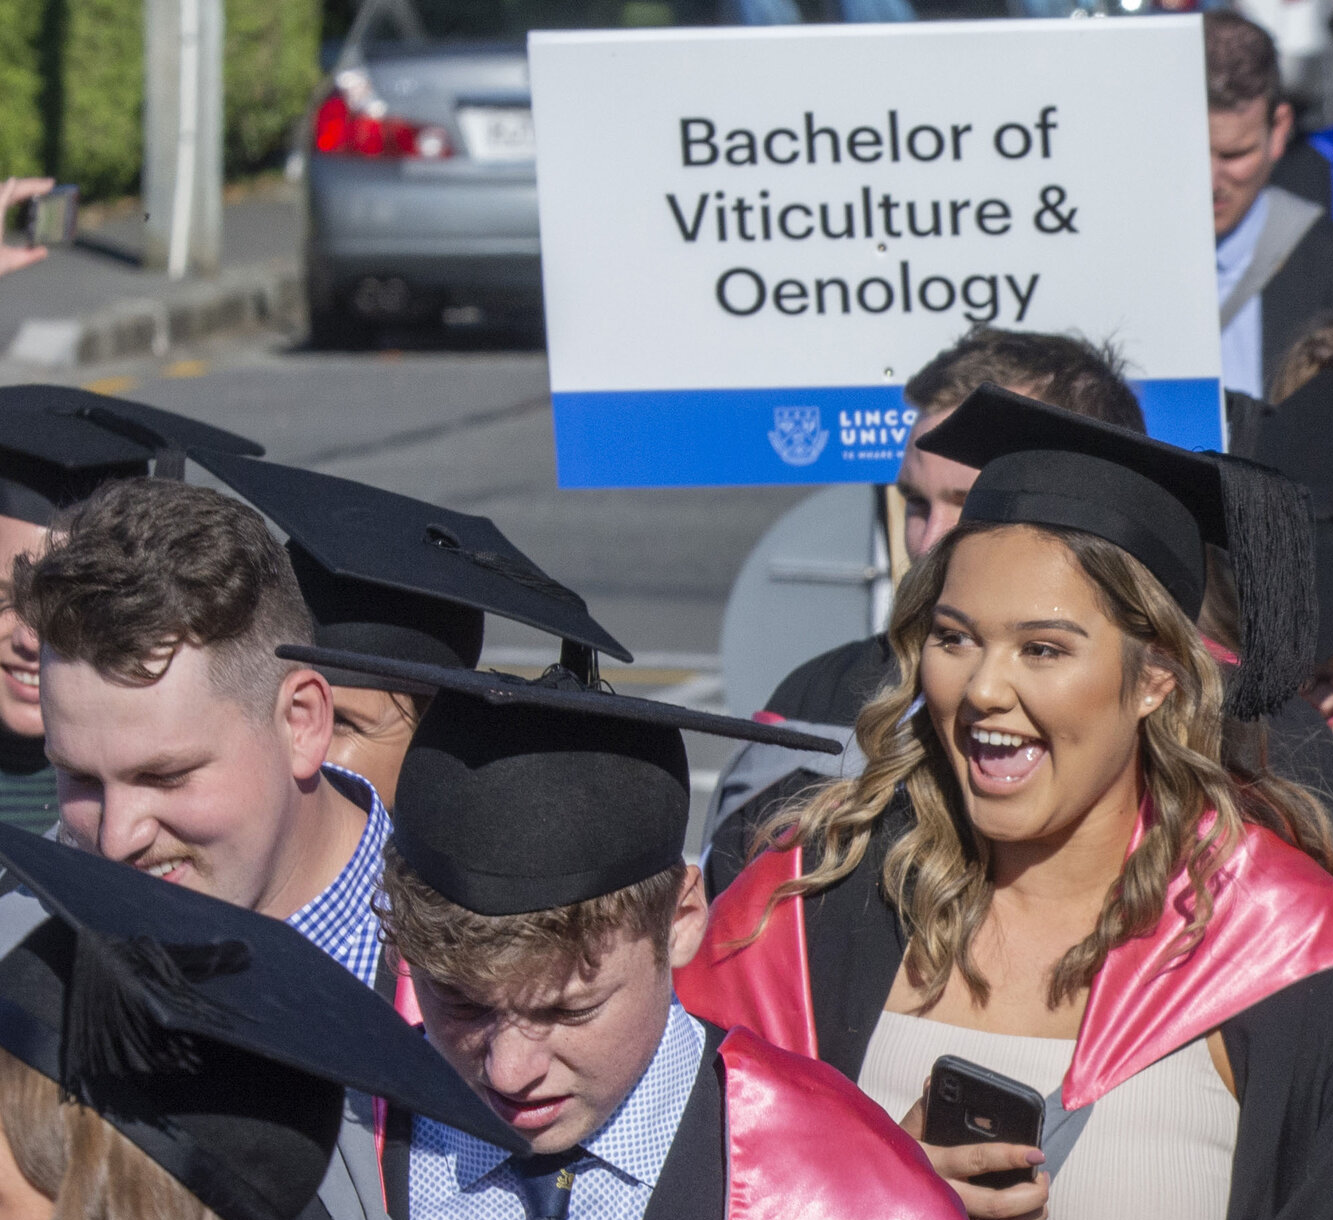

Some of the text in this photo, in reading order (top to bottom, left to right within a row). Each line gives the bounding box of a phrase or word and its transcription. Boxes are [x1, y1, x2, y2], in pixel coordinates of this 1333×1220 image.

[679, 105, 1058, 167] Bachelor of
[665, 184, 1079, 242] Viticulture &
[715, 260, 1040, 323] Oenology
[840, 409, 917, 427] LINCO
[841, 428, 906, 445] UNIV
